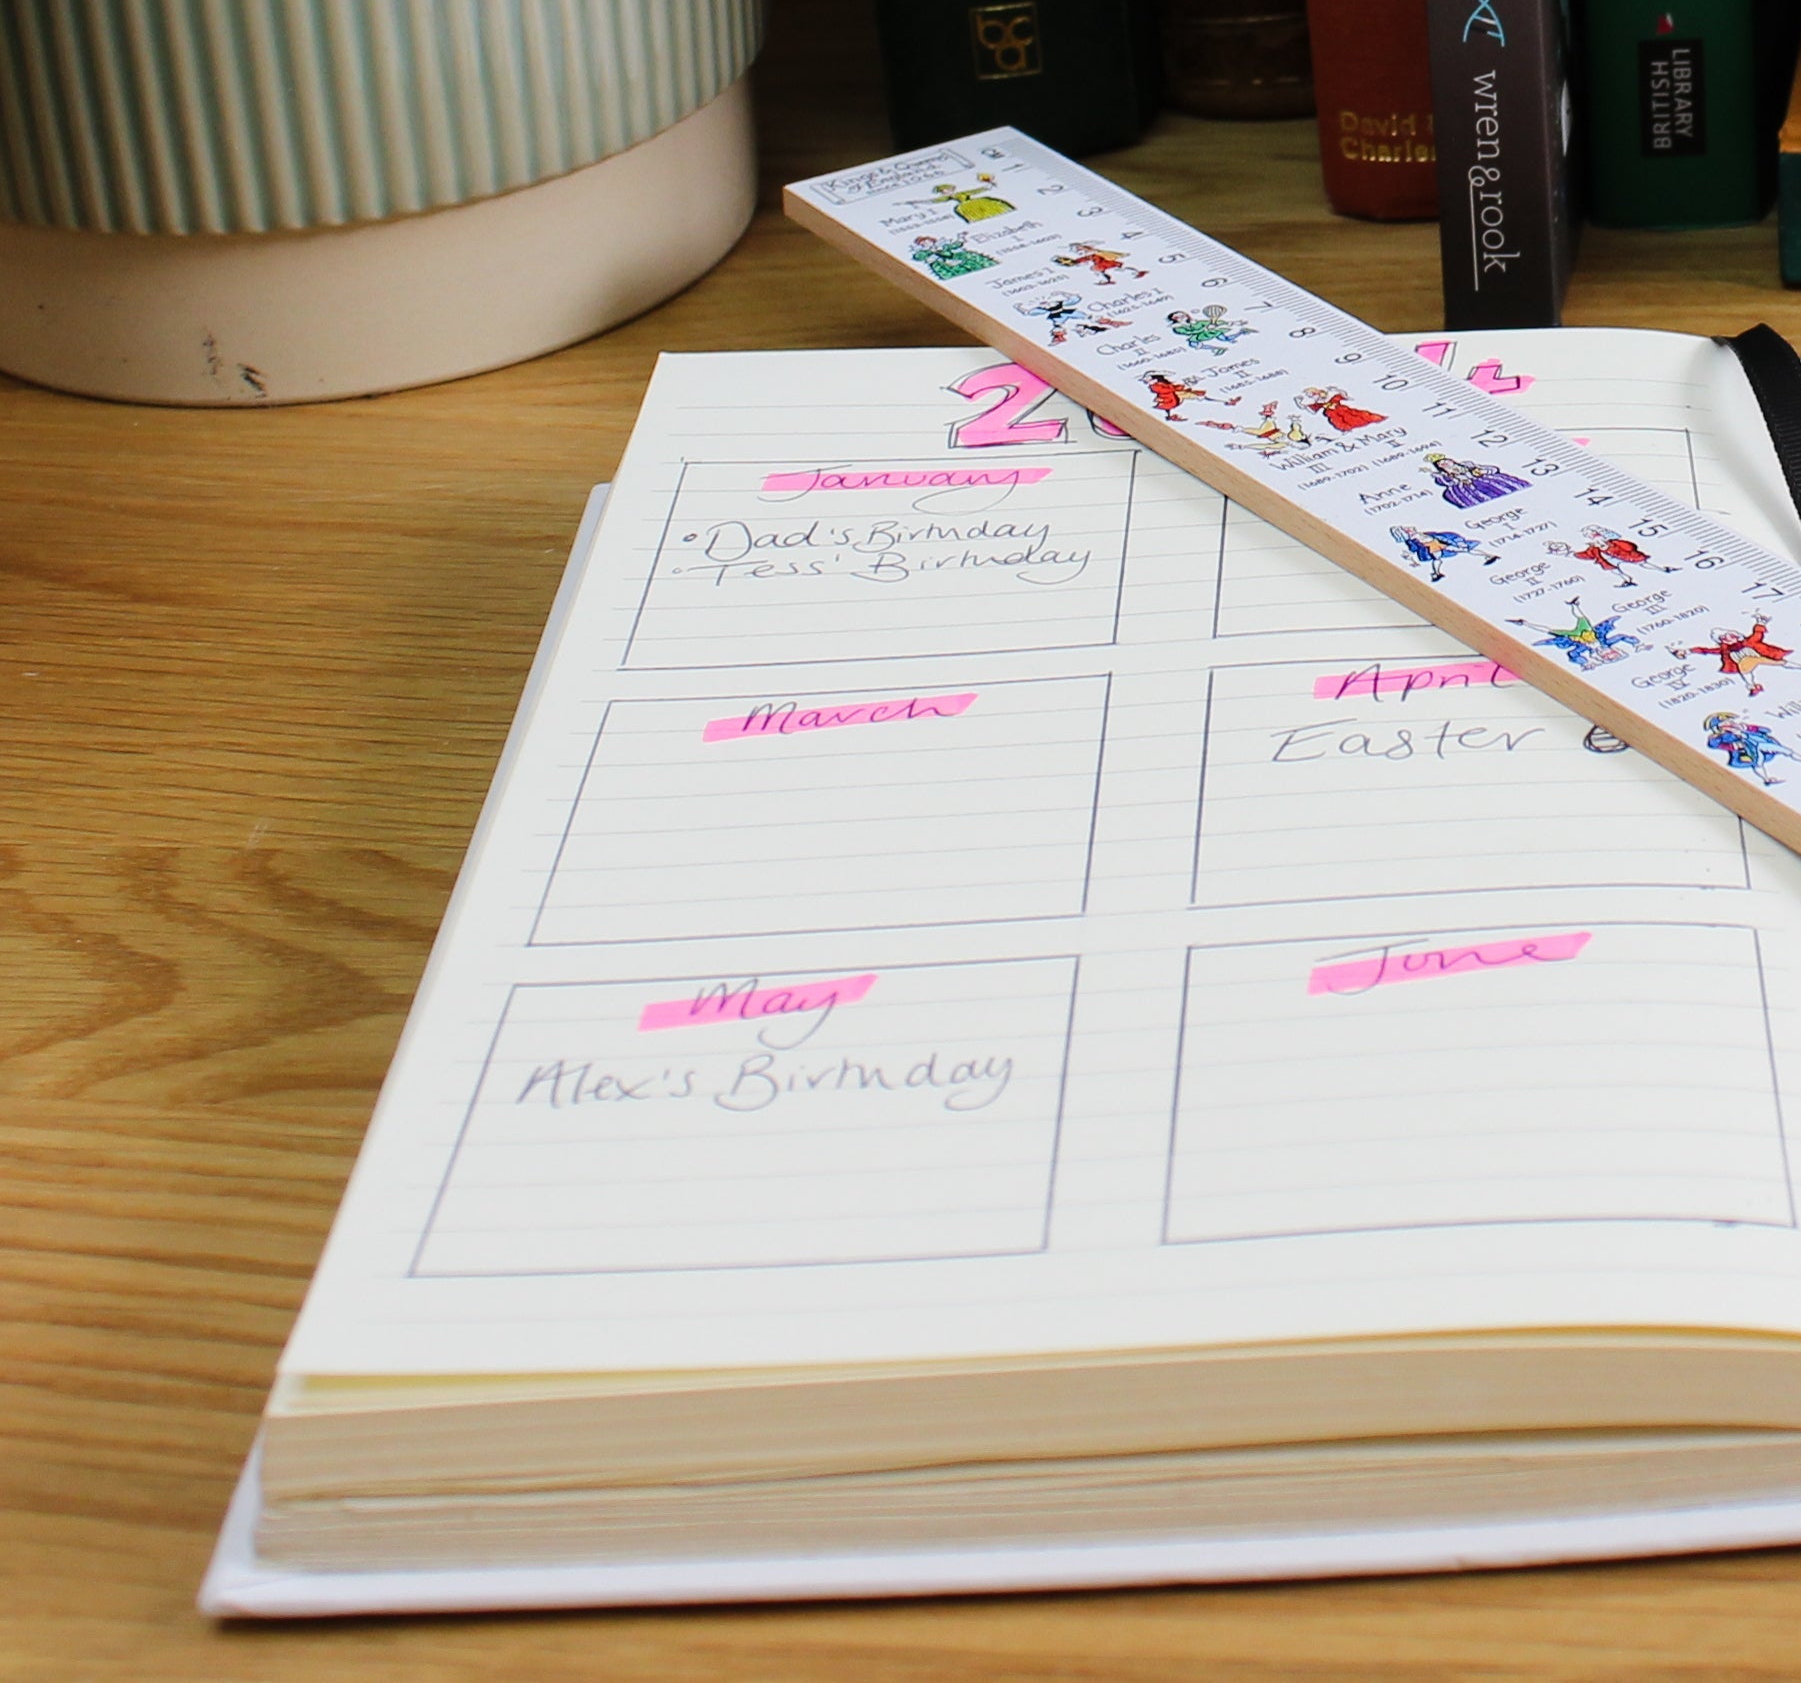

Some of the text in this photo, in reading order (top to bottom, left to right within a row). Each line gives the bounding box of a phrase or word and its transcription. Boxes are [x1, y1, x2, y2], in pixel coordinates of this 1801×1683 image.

[1651, 61, 1673, 149] BRITISH
[1672, 48, 1694, 138] LIBRARY
[1373, 373, 1409, 392] 10
[1421, 400, 1458, 420] 11
[1269, 448, 1340, 472] William
[1359, 426, 1408, 448] Mary
[1470, 427, 1509, 449] 12
[1520, 456, 1560, 478] 13
[757, 464, 1020, 515] January
[1357, 482, 1414, 505] Anne
[1573, 487, 1615, 508] 14
[1465, 505, 1529, 531] George
[1628, 517, 1668, 539] 15
[705, 519, 1051, 562] Dad's Birthday
[686, 549, 1092, 587] Tess' Birthday
[1487, 560, 1552, 586] George
[1683, 548, 1726, 572] 16
[1610, 587, 1674, 614] George
[1740, 581, 1787, 603] 17
[1630, 662, 1698, 690] George
[742, 696, 958, 736] March
[1270, 717, 1546, 763] Easter
[1314, 937, 1575, 996] June
[690, 977, 839, 1050] May
[515, 1051, 1018, 1112] Alex's Birthday
